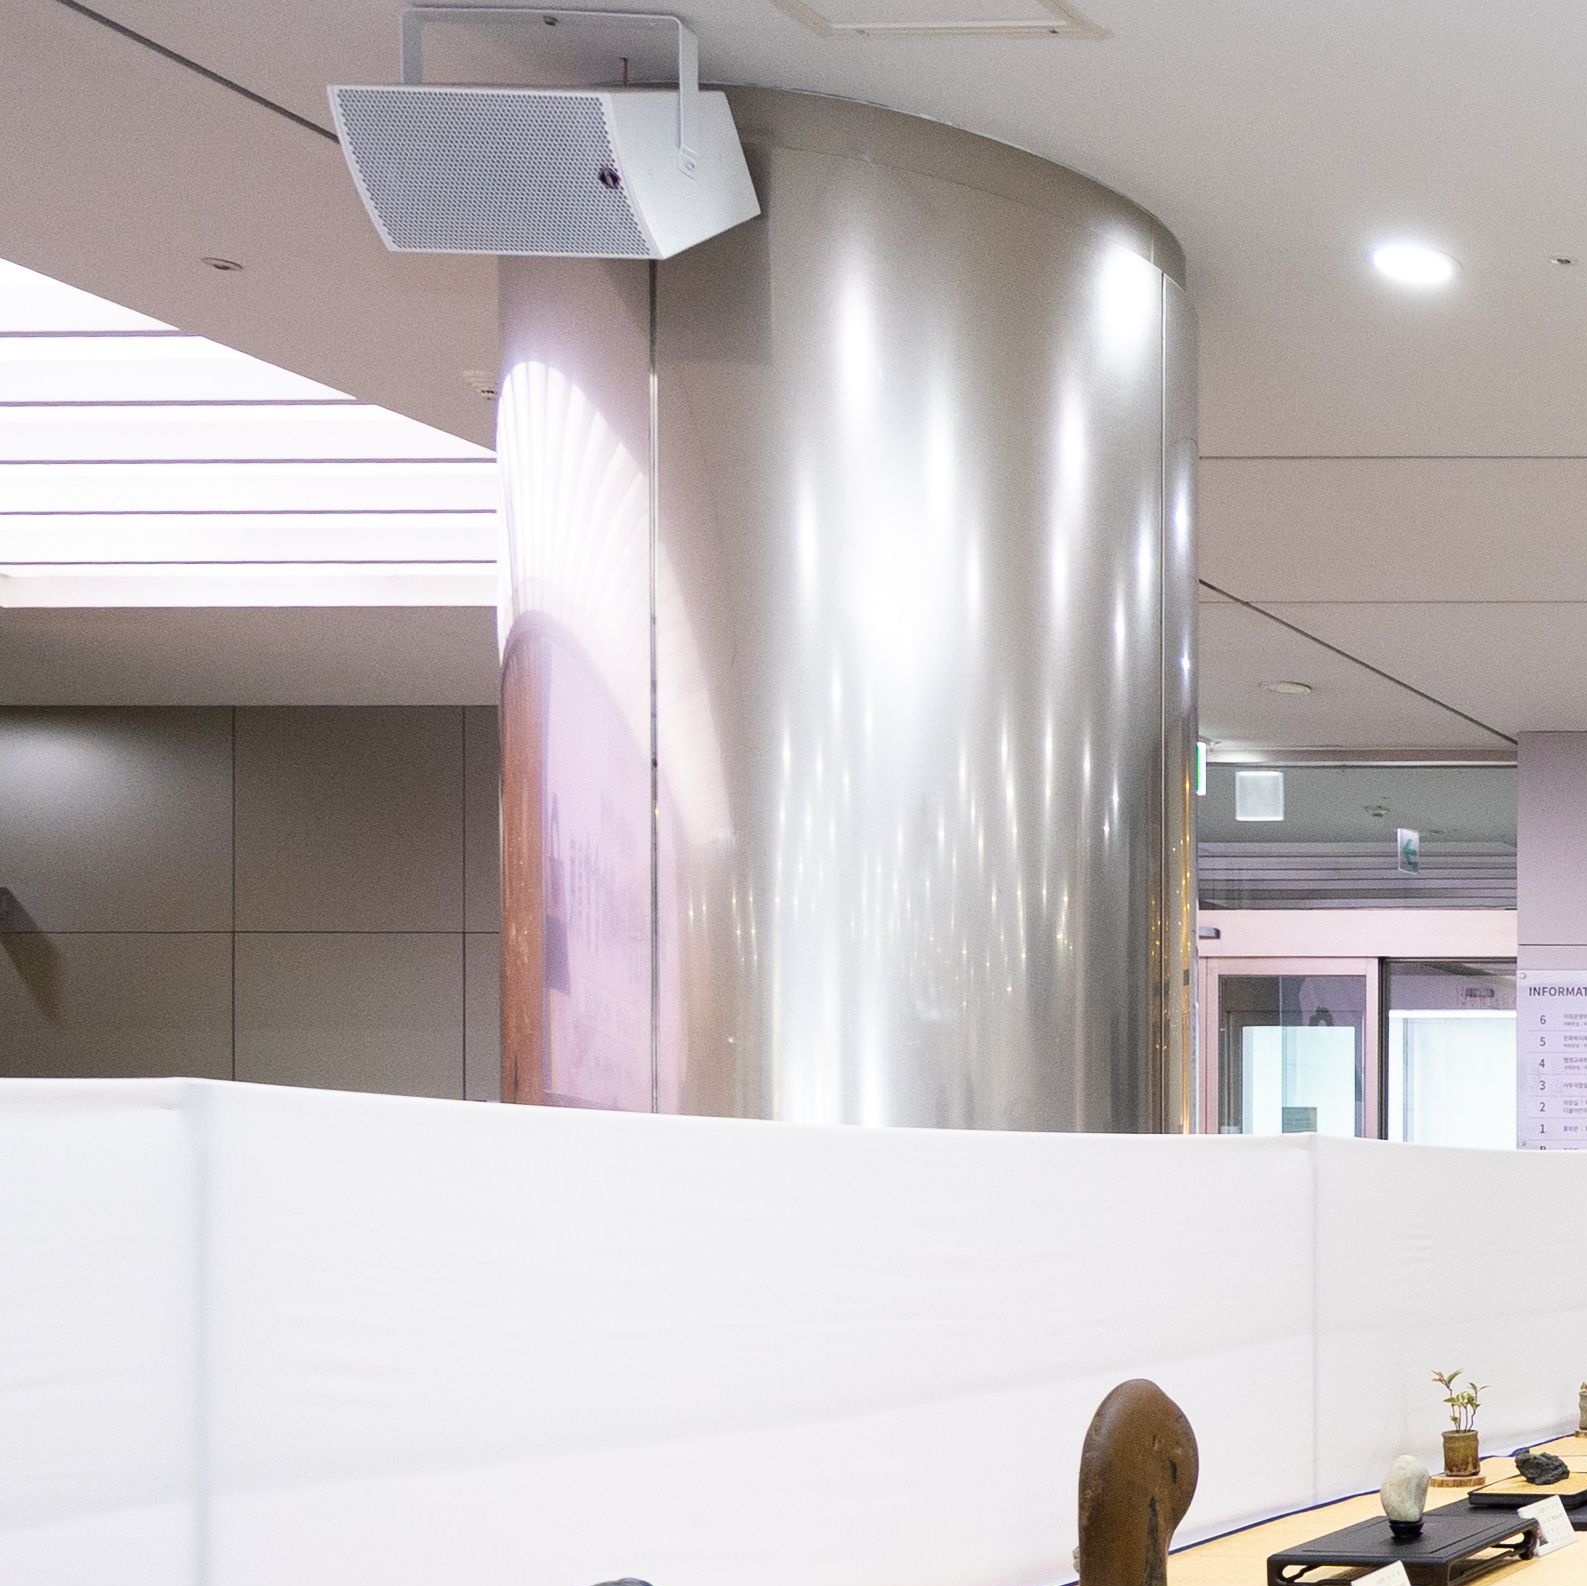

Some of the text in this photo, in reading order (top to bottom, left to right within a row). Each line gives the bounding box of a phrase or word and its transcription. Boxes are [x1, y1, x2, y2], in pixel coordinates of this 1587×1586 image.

[1539, 1014, 1547, 1025] 6
[1539, 1036, 1547, 1047] 5
[1538, 1058, 1546, 1069] 4
[1539, 1080, 1546, 1091] 3
[1539, 1101, 1546, 1112] 2
[1539, 1123, 1546, 1134] 1
